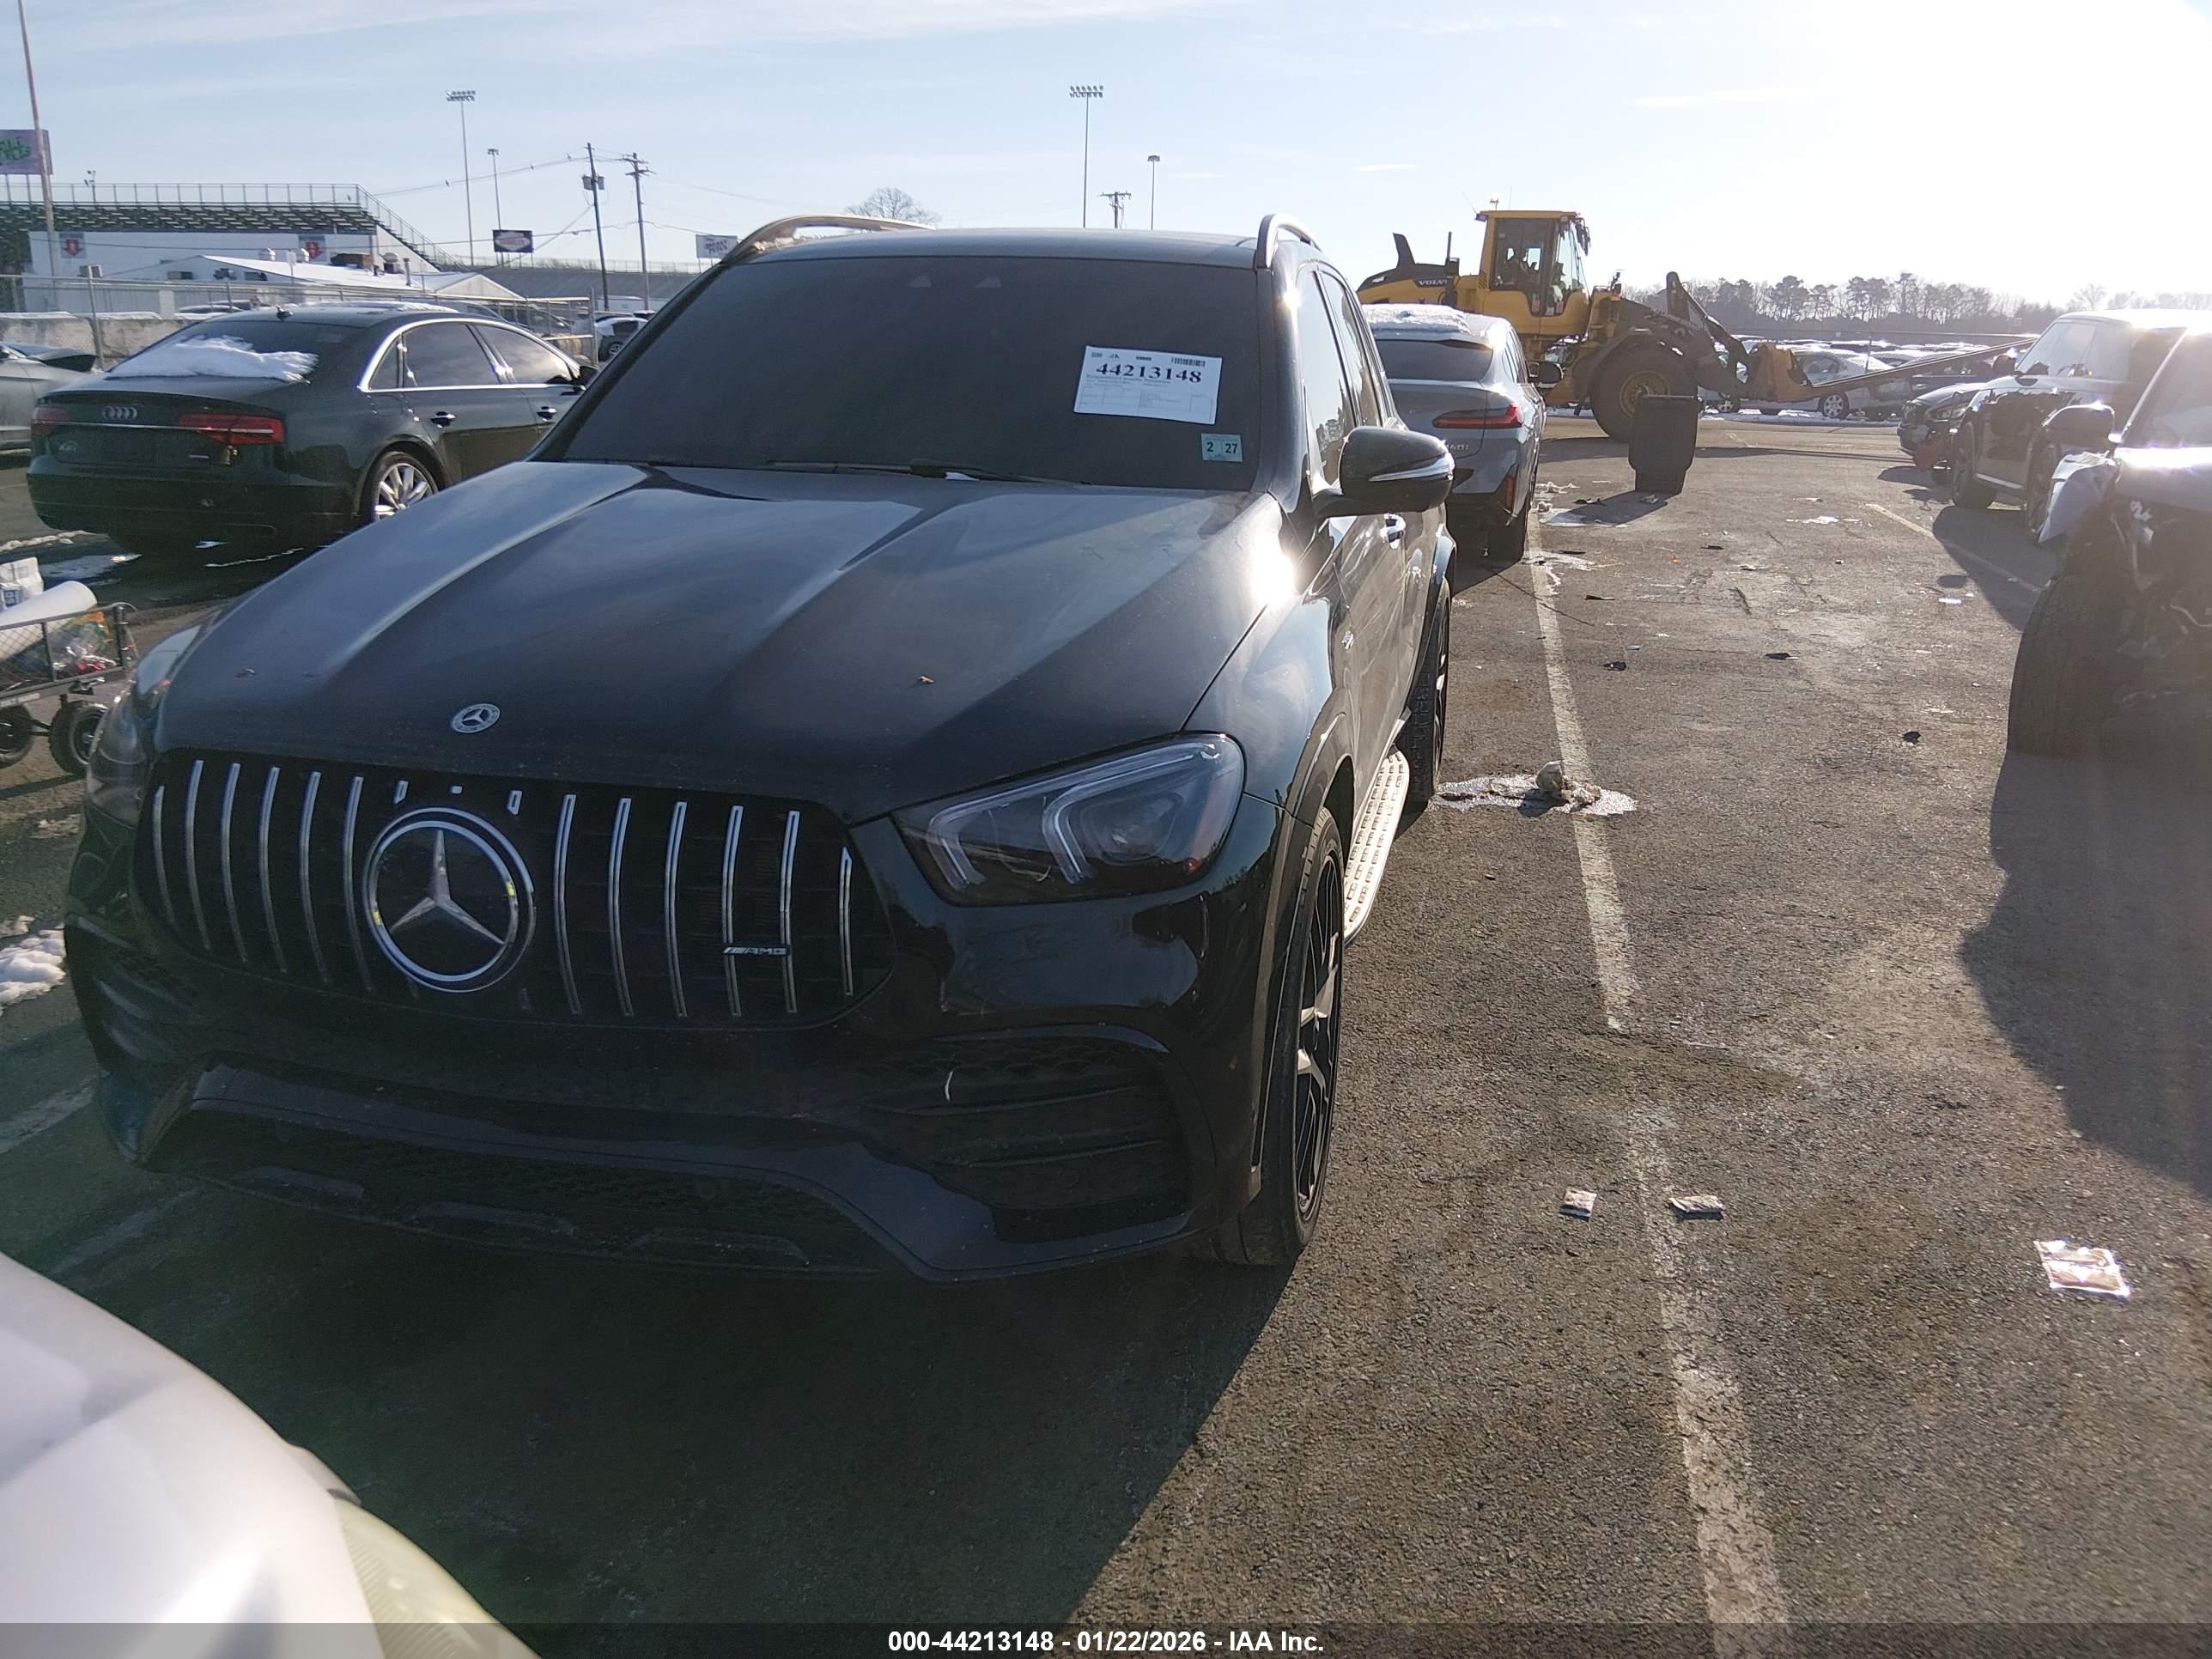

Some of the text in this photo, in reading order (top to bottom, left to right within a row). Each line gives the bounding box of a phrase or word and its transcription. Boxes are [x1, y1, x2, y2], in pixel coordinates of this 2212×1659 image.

[1097, 363, 1201, 383] 44213148
[1206, 441, 1238, 454] 2 27
